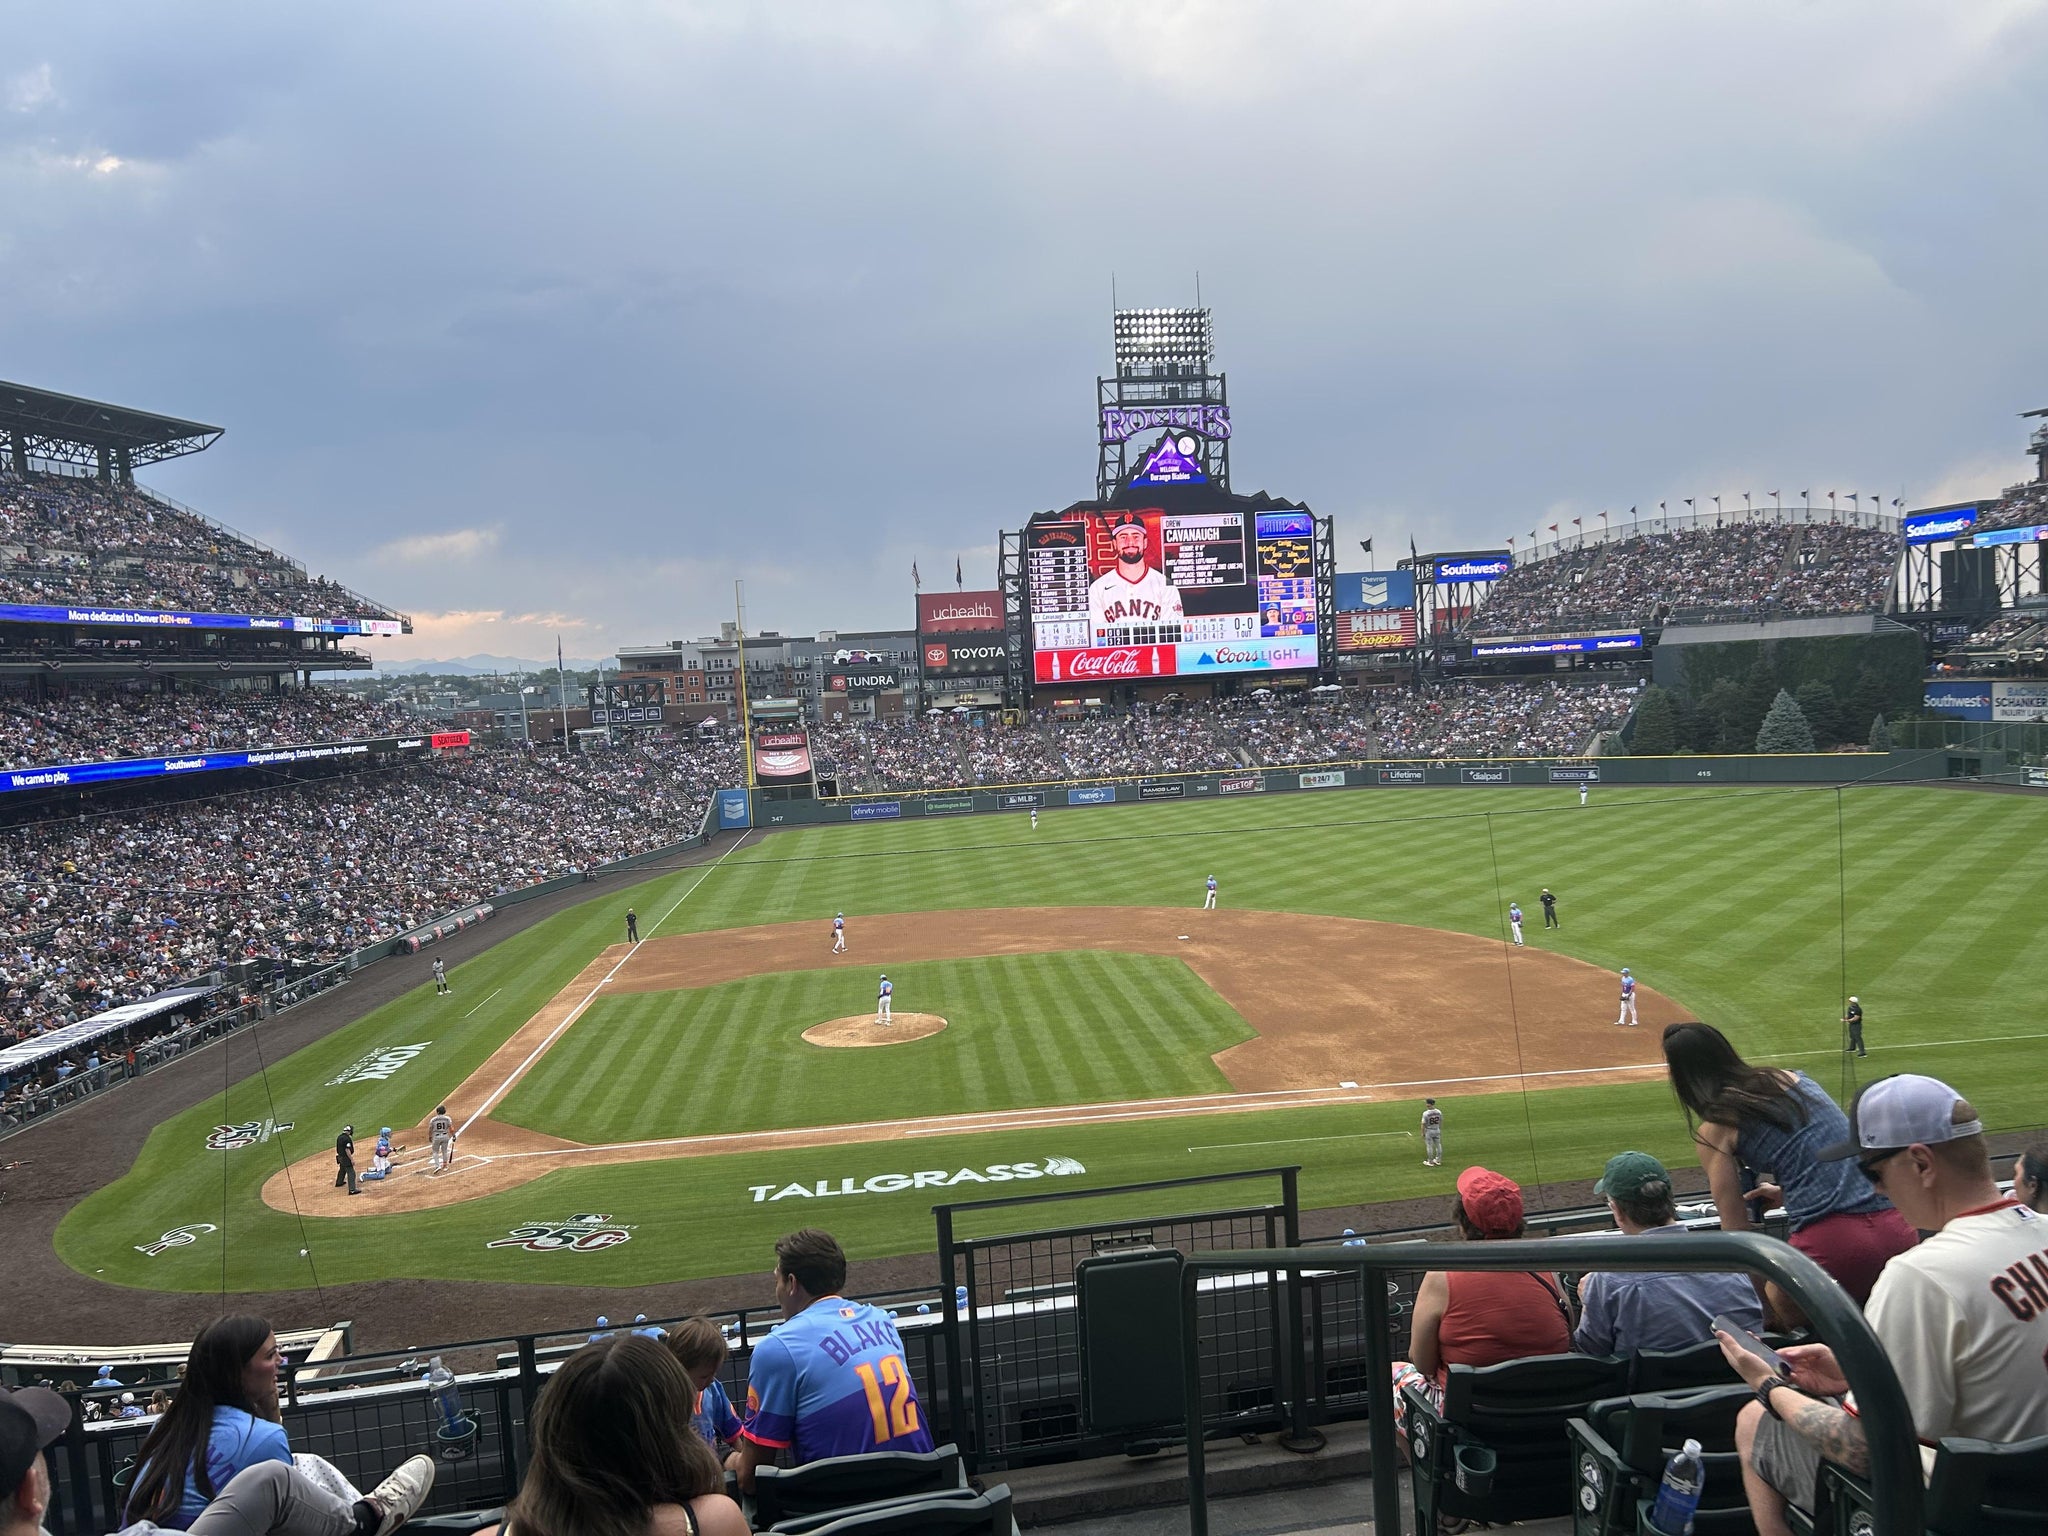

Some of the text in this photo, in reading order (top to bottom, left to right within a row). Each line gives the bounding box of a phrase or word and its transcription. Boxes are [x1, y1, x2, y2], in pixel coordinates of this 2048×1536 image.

[1102, 406, 1232, 441] ROCKIES
[1906, 518, 1964, 537] Southwest
[1166, 528, 1220, 542] CAVANAUGH
[1441, 563, 1500, 576] Southwest
[68, 610, 192, 624] More dedicated to Denver DEN-ever.
[933, 602, 992, 620] uchealth
[1104, 599, 1161, 623] GIANTS
[1306, 613, 1314, 621] 25
[250, 618, 280, 628] Southwest
[1350, 614, 1402, 632] KING
[1937, 626, 1968, 634] PLATTE
[1351, 632, 1403, 646] Soopers
[1597, 640, 1631, 649] Southwest
[952, 647, 1005, 659] TOYOTA
[1216, 647, 1300, 664] Coors LIGHT
[1494, 646, 1523, 654] dedicated
[1070, 649, 1140, 676] Coca-Cola
[847, 675, 894, 687] TUNDRA
[1923, 694, 1981, 707] Southwest
[398, 740, 421, 748] Southwest
[438, 735, 463, 746] SEATGEEK
[764, 735, 801, 745] uchealth
[248, 746, 368, 763] Assigned seating. Extra legroom. In-seat power.
[164, 759, 201, 770] Southwest
[12, 771, 69, 786] We came to play.
[1390, 771, 1421, 779] Lifetime
[1472, 772, 1502, 781] dialpad
[876, 806, 898, 814] mobile
[346, 1041, 432, 1083] YORK
[1430, 1116, 1440, 1125] 82
[748, 1162, 1044, 1202] TALLGRASS
[854, 1354, 920, 1445] 12
